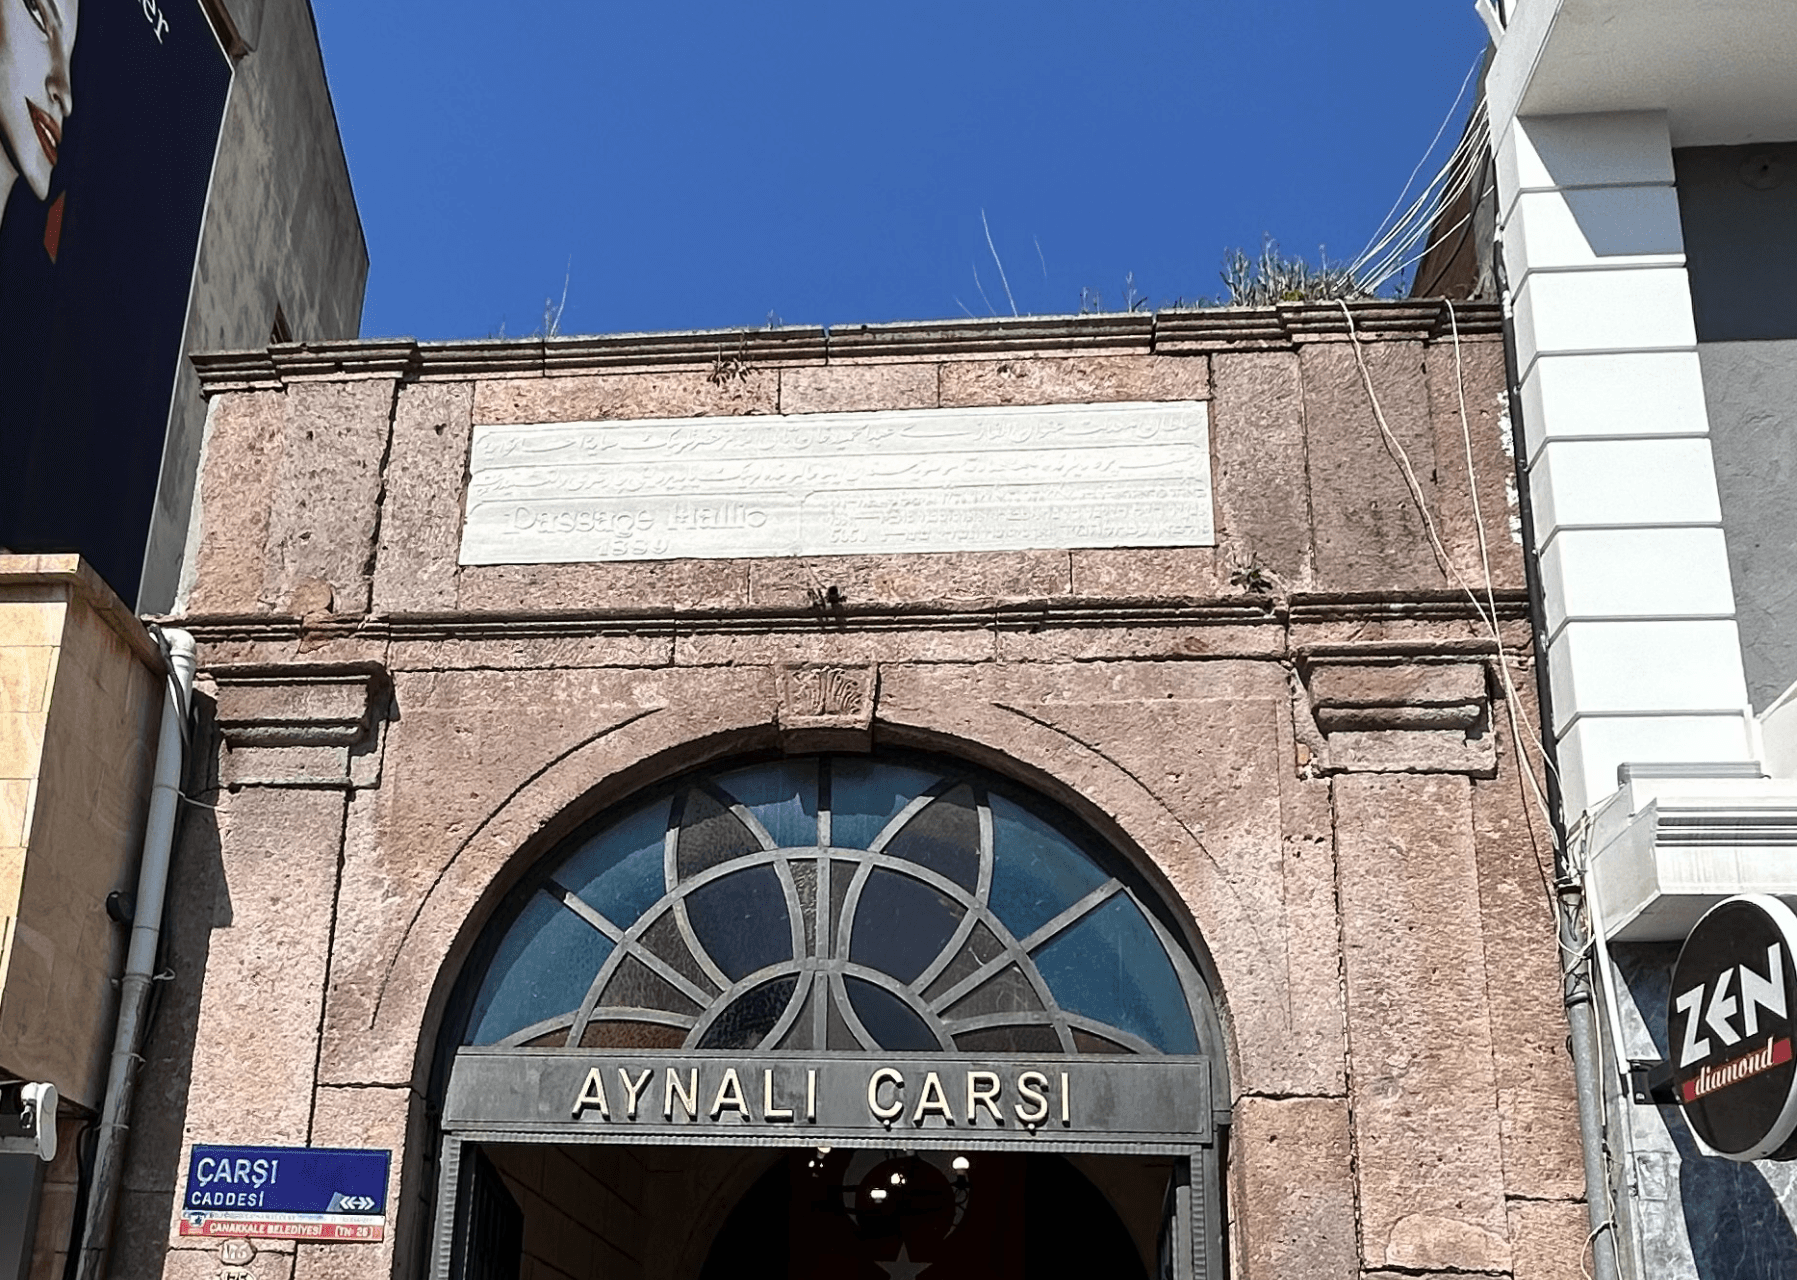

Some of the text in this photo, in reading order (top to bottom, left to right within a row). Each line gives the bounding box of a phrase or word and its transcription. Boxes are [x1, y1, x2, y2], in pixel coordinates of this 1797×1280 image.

[1675, 941, 1788, 1068] ZEN
[571, 1066, 818, 1124] AYNALI
[1694, 1035, 1776, 1097] diamond
[196, 1157, 279, 1189] ÇARŞI
[209, 1222, 265, 1234] ÇANAKKALE
